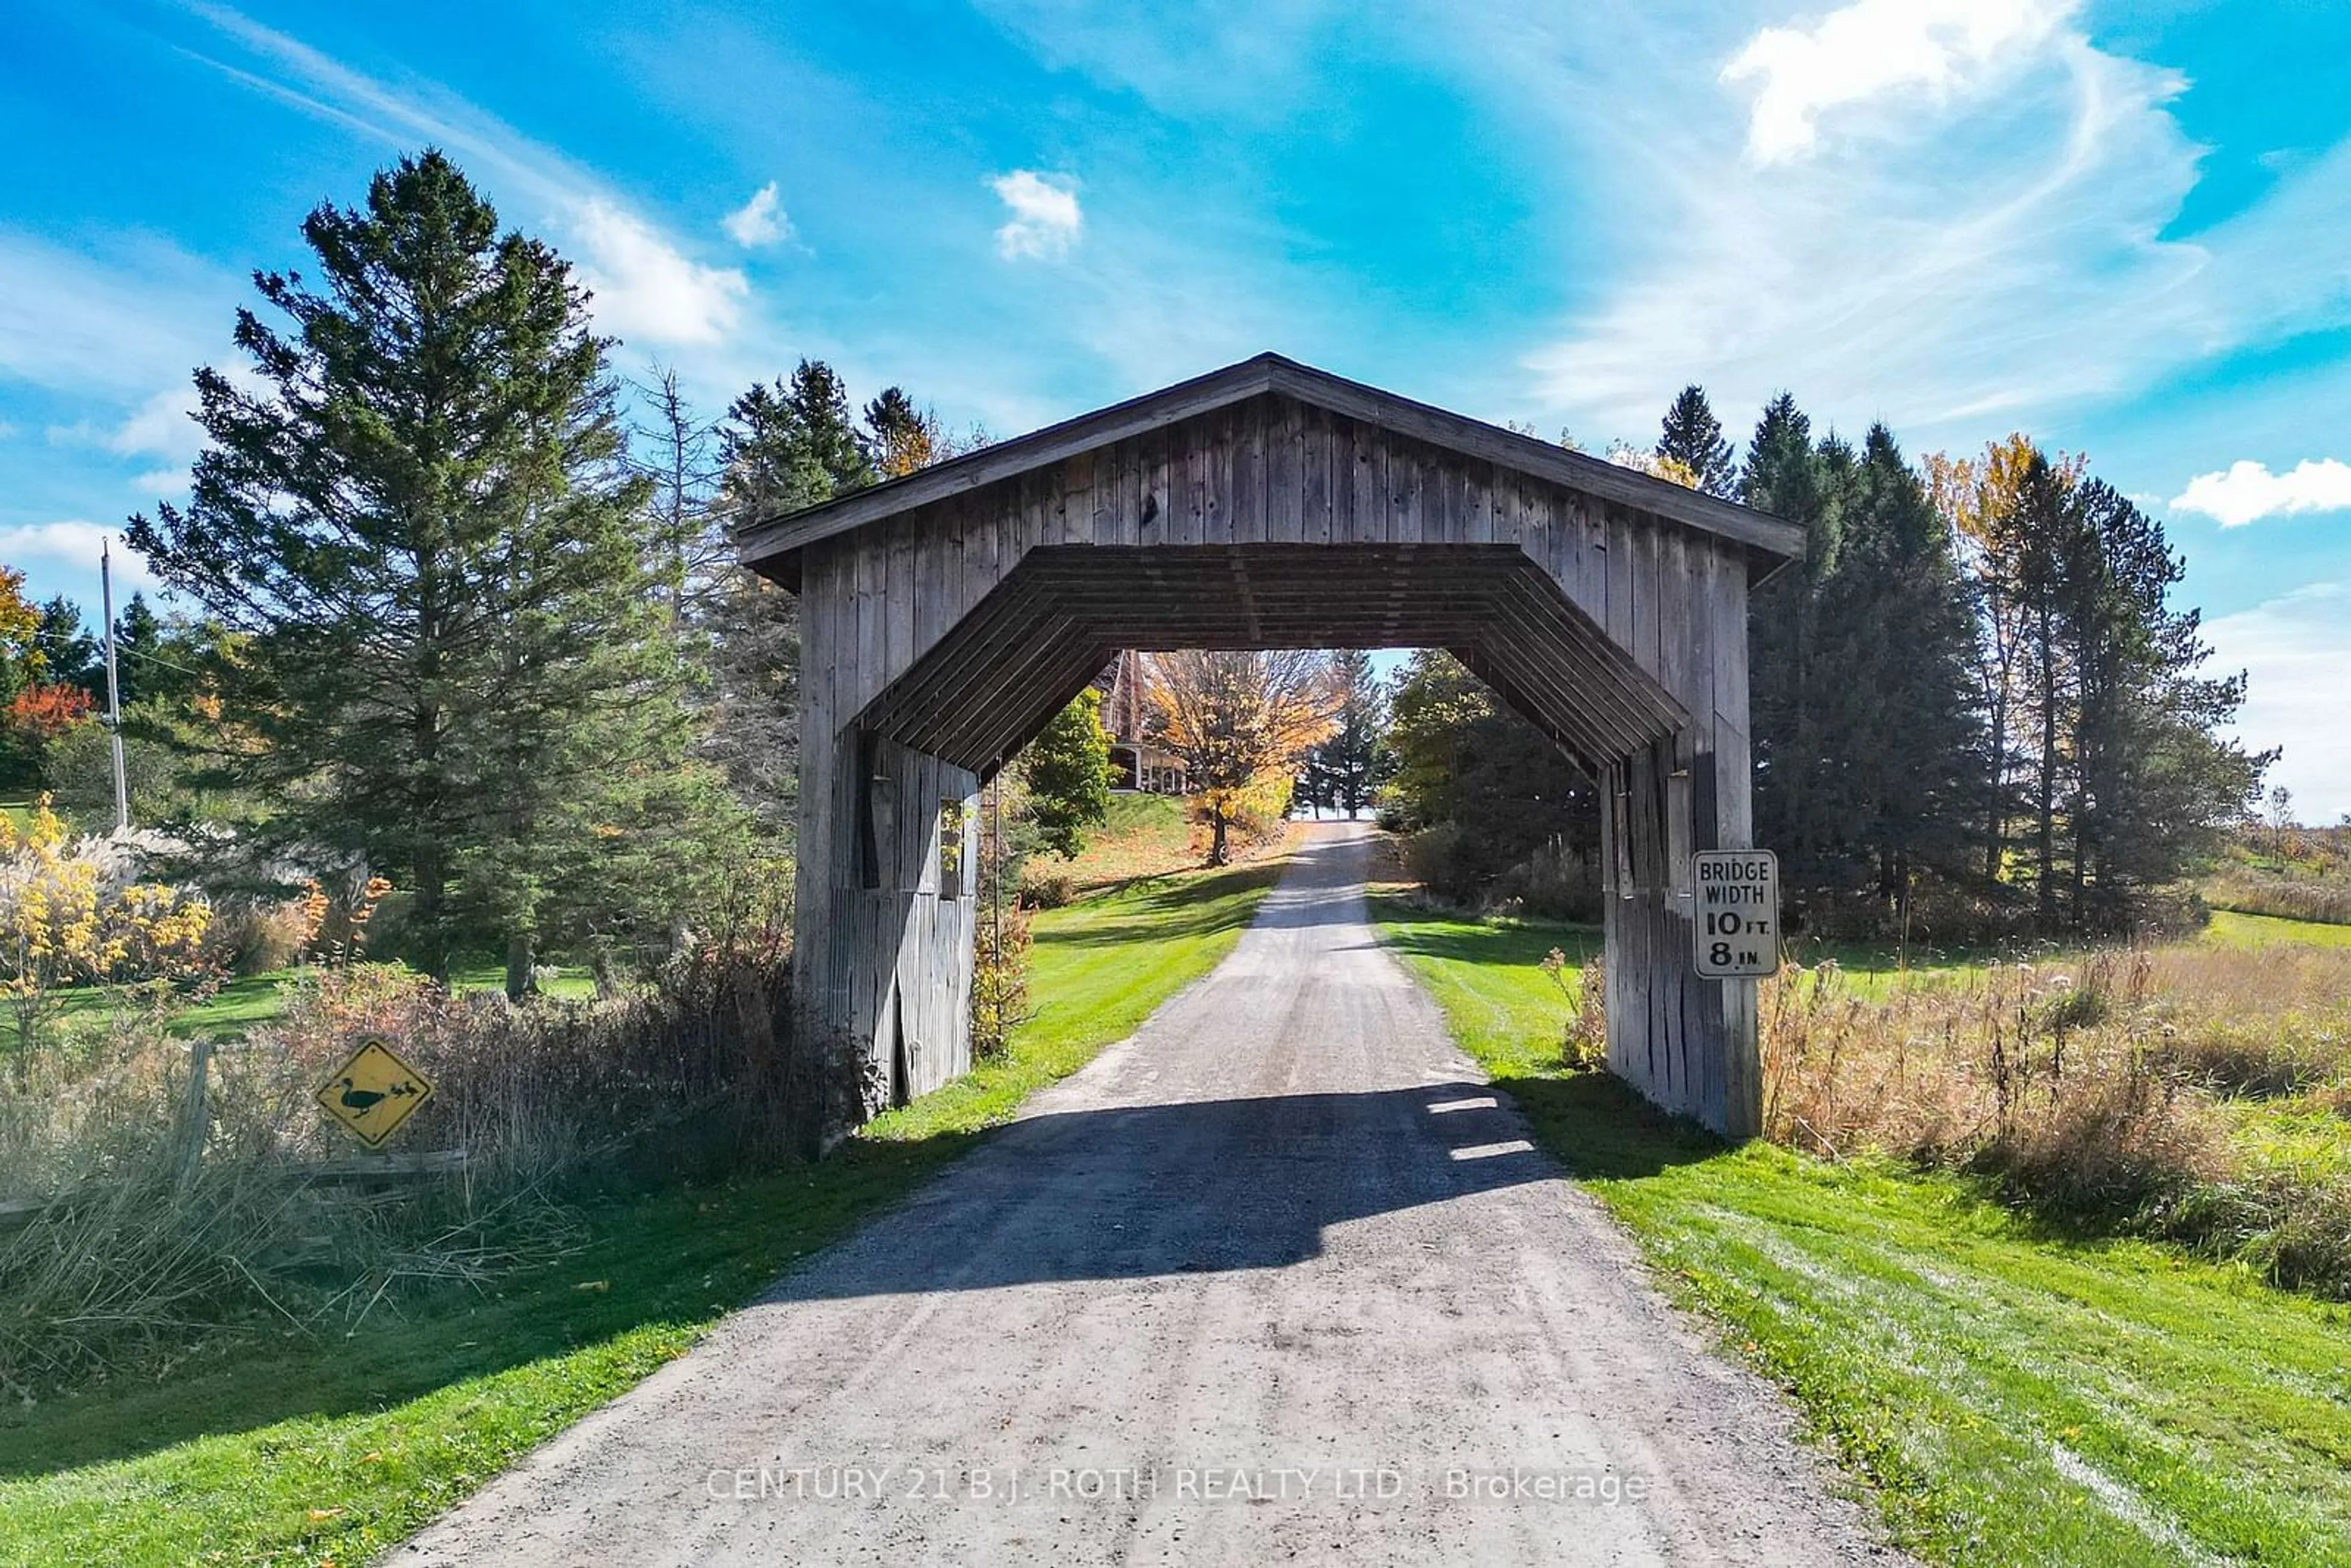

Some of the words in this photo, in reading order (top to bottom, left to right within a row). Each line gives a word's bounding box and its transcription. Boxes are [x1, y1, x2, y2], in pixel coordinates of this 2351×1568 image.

[1701, 862, 1769, 881] BRIDGE
[1706, 885, 1764, 904] WIDTH
[1708, 912, 1741, 936] 10
[1746, 921, 1770, 935] FT.
[1710, 942, 1732, 966] 8
